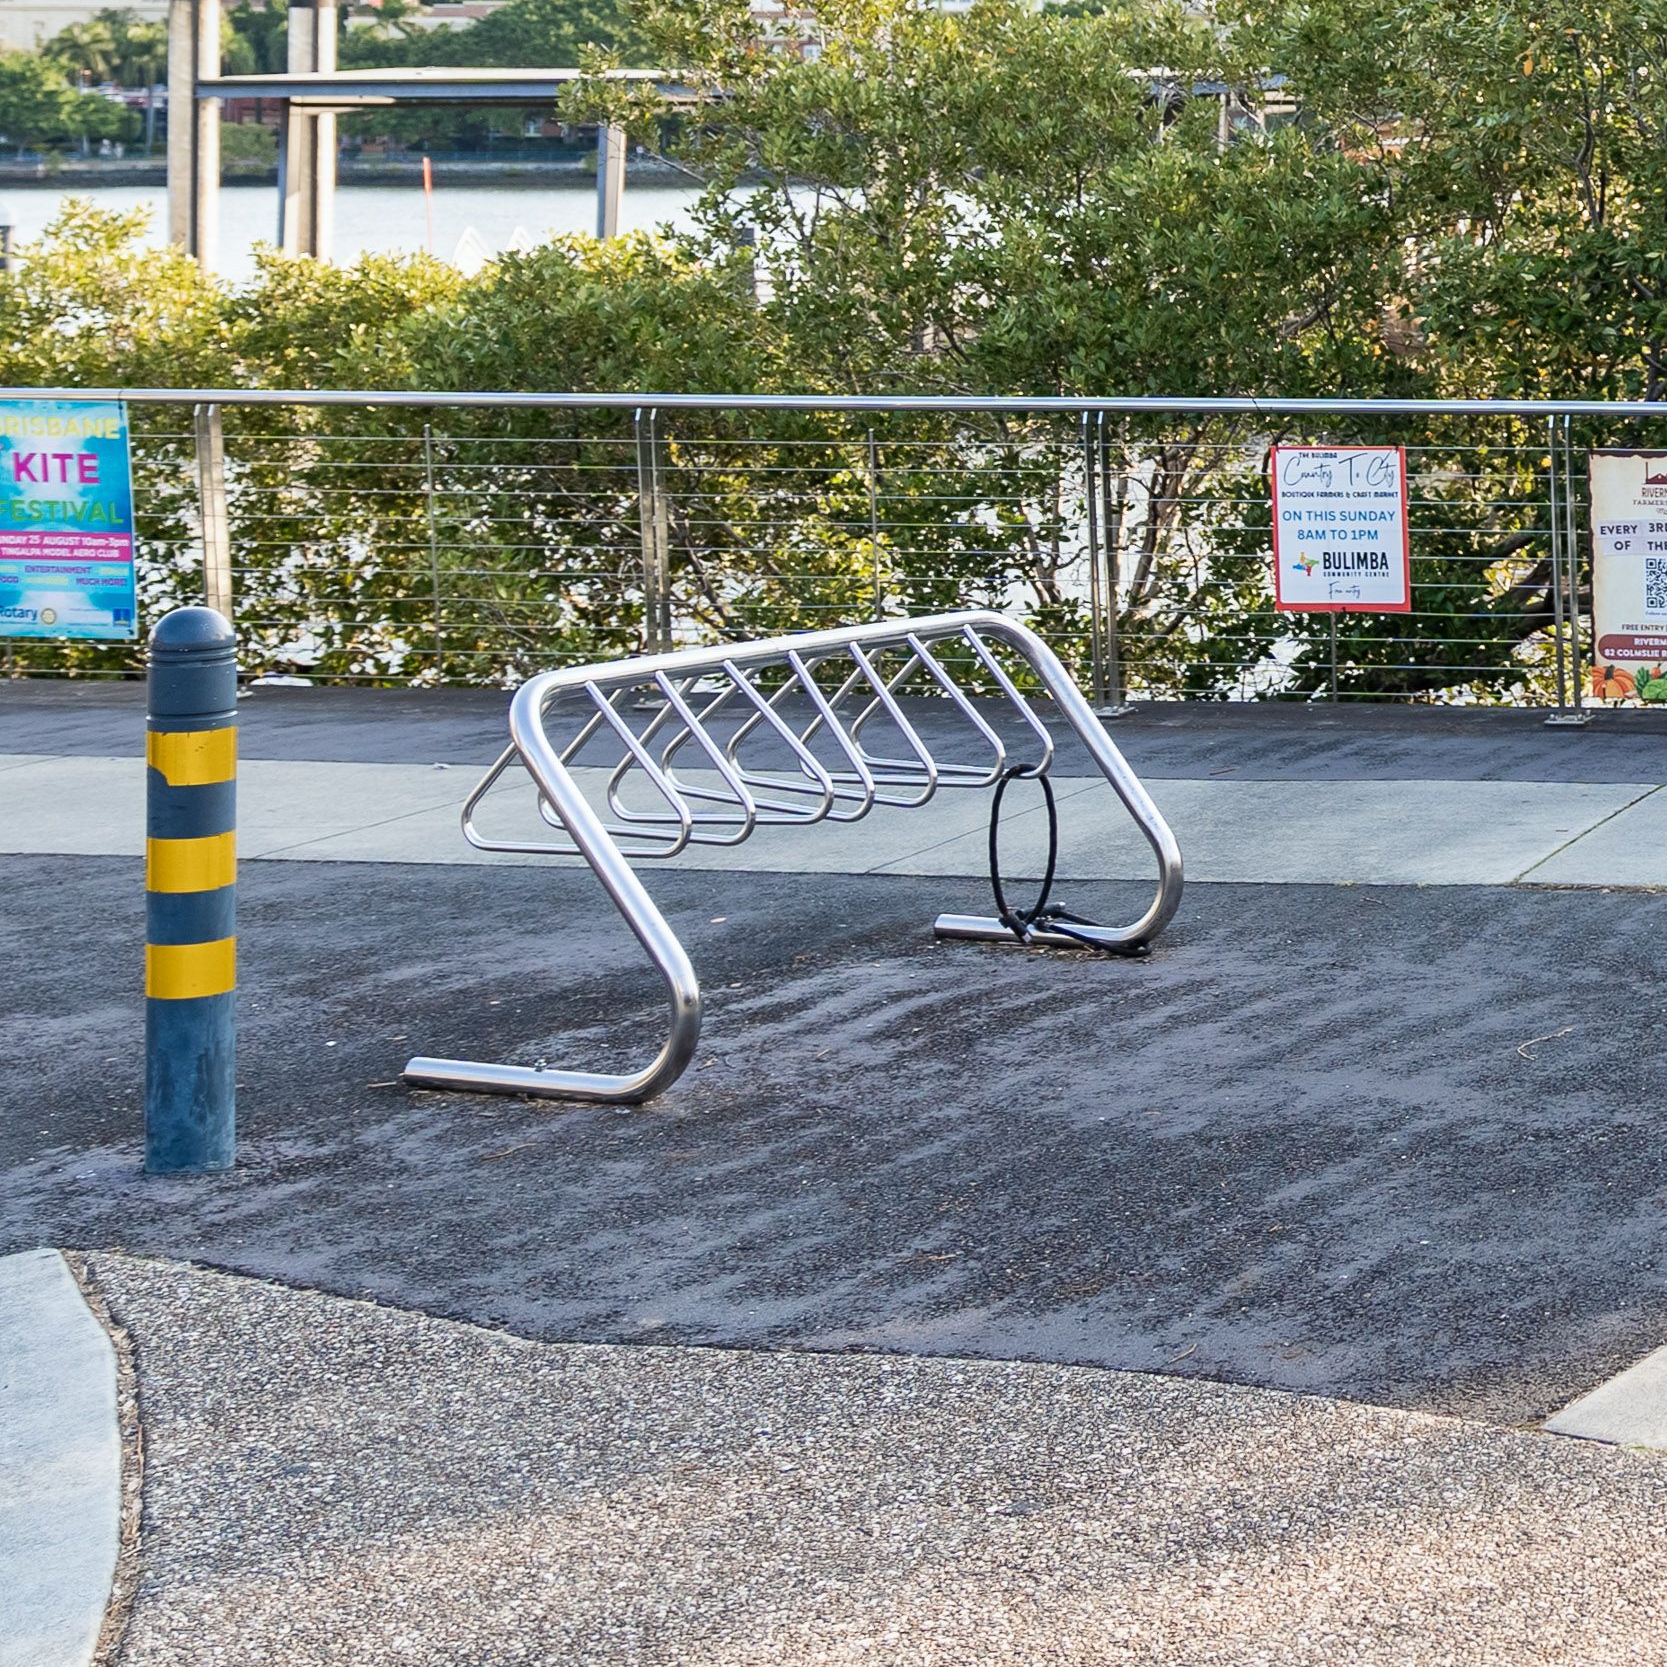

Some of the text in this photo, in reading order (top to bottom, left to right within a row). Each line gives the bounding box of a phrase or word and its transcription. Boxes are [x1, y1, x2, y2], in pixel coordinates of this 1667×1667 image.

[0, 416, 119, 439] RISBANE
[12, 452, 100, 484] KITE
[1282, 510, 1395, 521] ON THIS SUNDAY
[1297, 529, 1378, 540] 8AM TO 1PM
[1600, 525, 1638, 535] EVERY
[43, 536, 80, 546] AUGUST
[1614, 541, 1631, 550] OF
[42, 548, 70, 556] MODEL
[72, 549, 96, 557] AERO
[97, 549, 120, 558] CLUB
[1322, 552, 1389, 570] BULIMBA
[24, 565, 92, 574] ENTERTAINMENT
[1616, 649, 1659, 657] COLMSLIE
